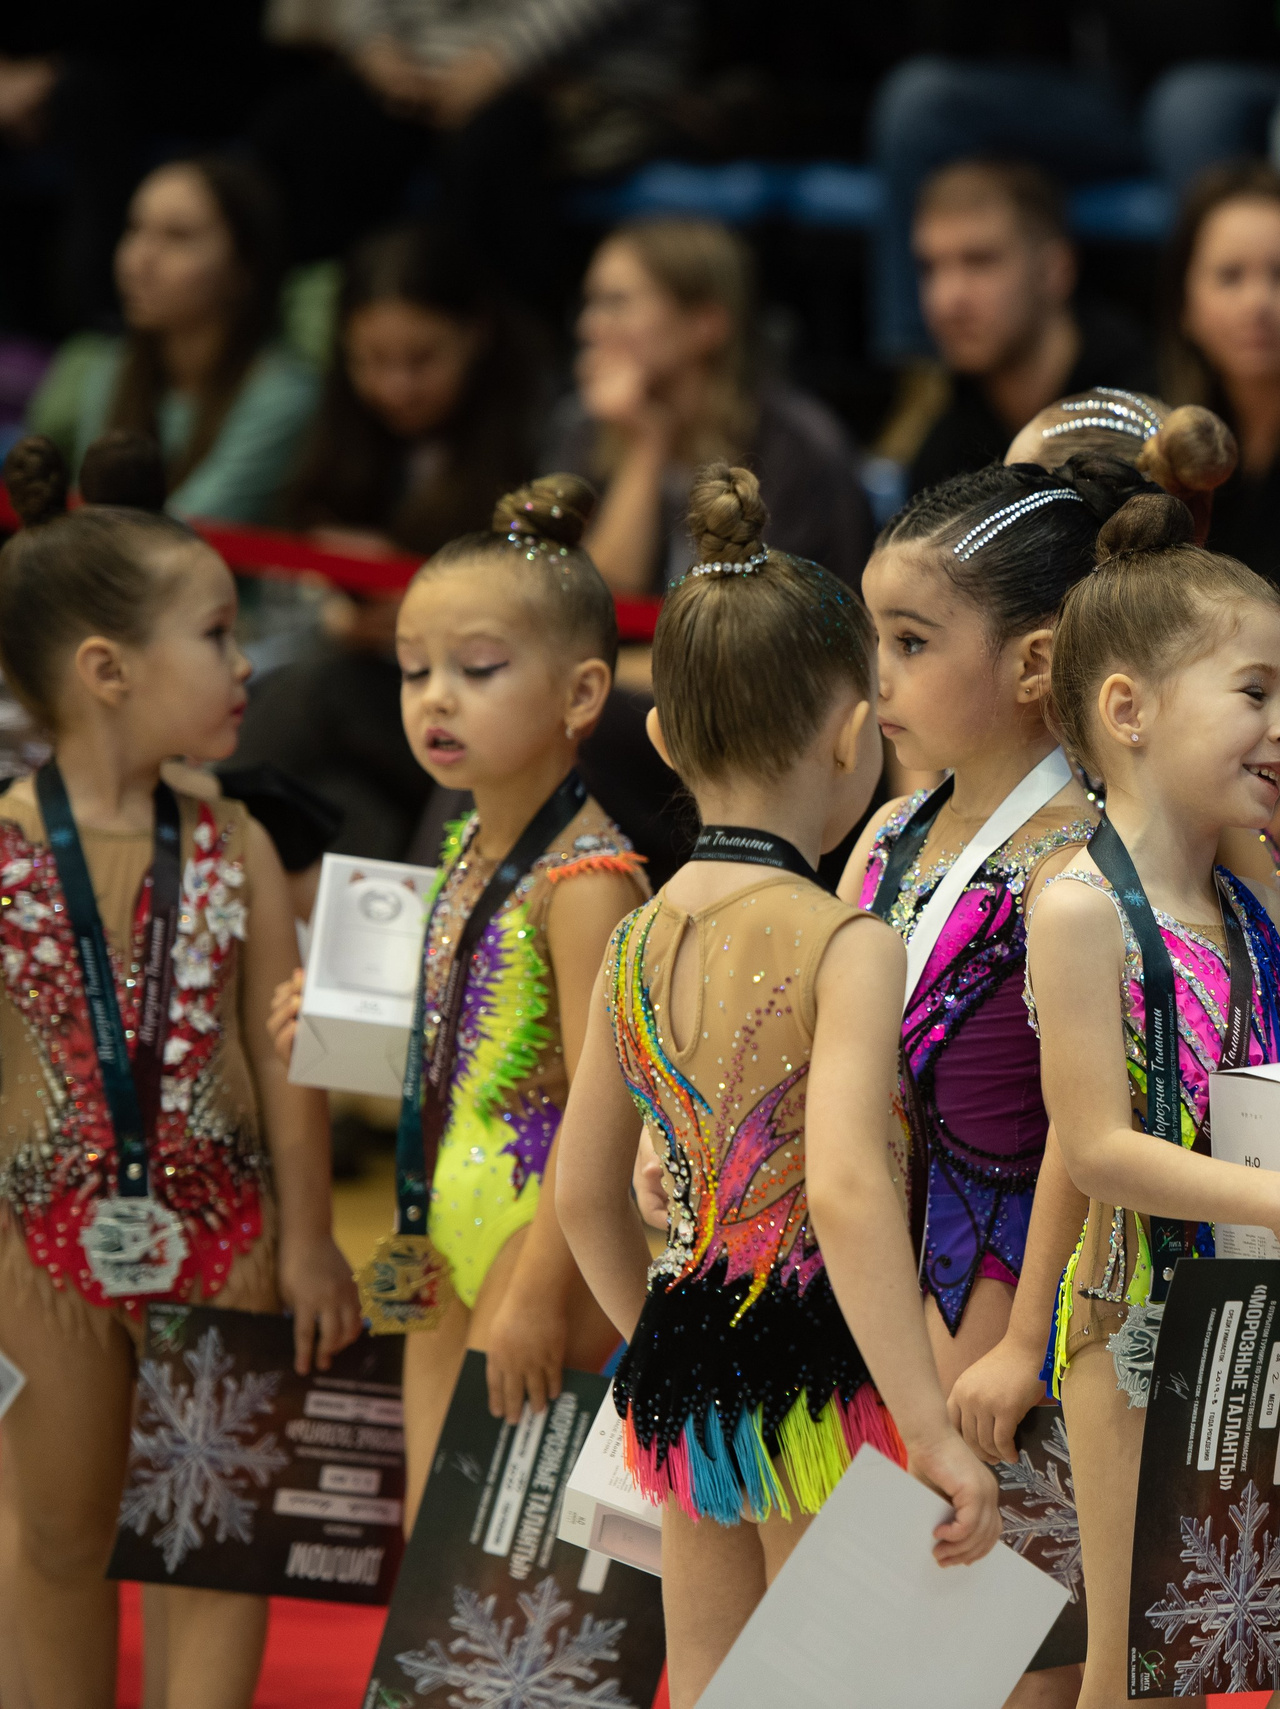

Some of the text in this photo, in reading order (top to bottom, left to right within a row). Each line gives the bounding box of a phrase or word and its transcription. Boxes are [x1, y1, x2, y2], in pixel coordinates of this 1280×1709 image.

[1224, 1309, 1235, 1328] СРЕДИ
[1262, 1305, 1276, 1338] ОТКРЫТОМ
[1218, 1329, 1230, 1362] ГИМНАСТОК
[1231, 1284, 1268, 1390] «МОРОЗНЫЕ
[1256, 1338, 1268, 1365] ТУРНИРЕ
[1255, 1365, 1262, 1374] ПО
[1272, 1371, 1280, 1384] 2
[1245, 1374, 1260, 1432] ХУДОЖЕСТВЕННОЙ
[1266, 1393, 1276, 1416] МЕСТО
[1207, 1412, 1216, 1428] ГОДА
[1203, 1428, 1213, 1461] РОЖДЕНИЯ
[1218, 1393, 1246, 1491] ТАЛАНТЫ»
[1240, 1432, 1251, 1472] ГИМНАСТИКЕ
